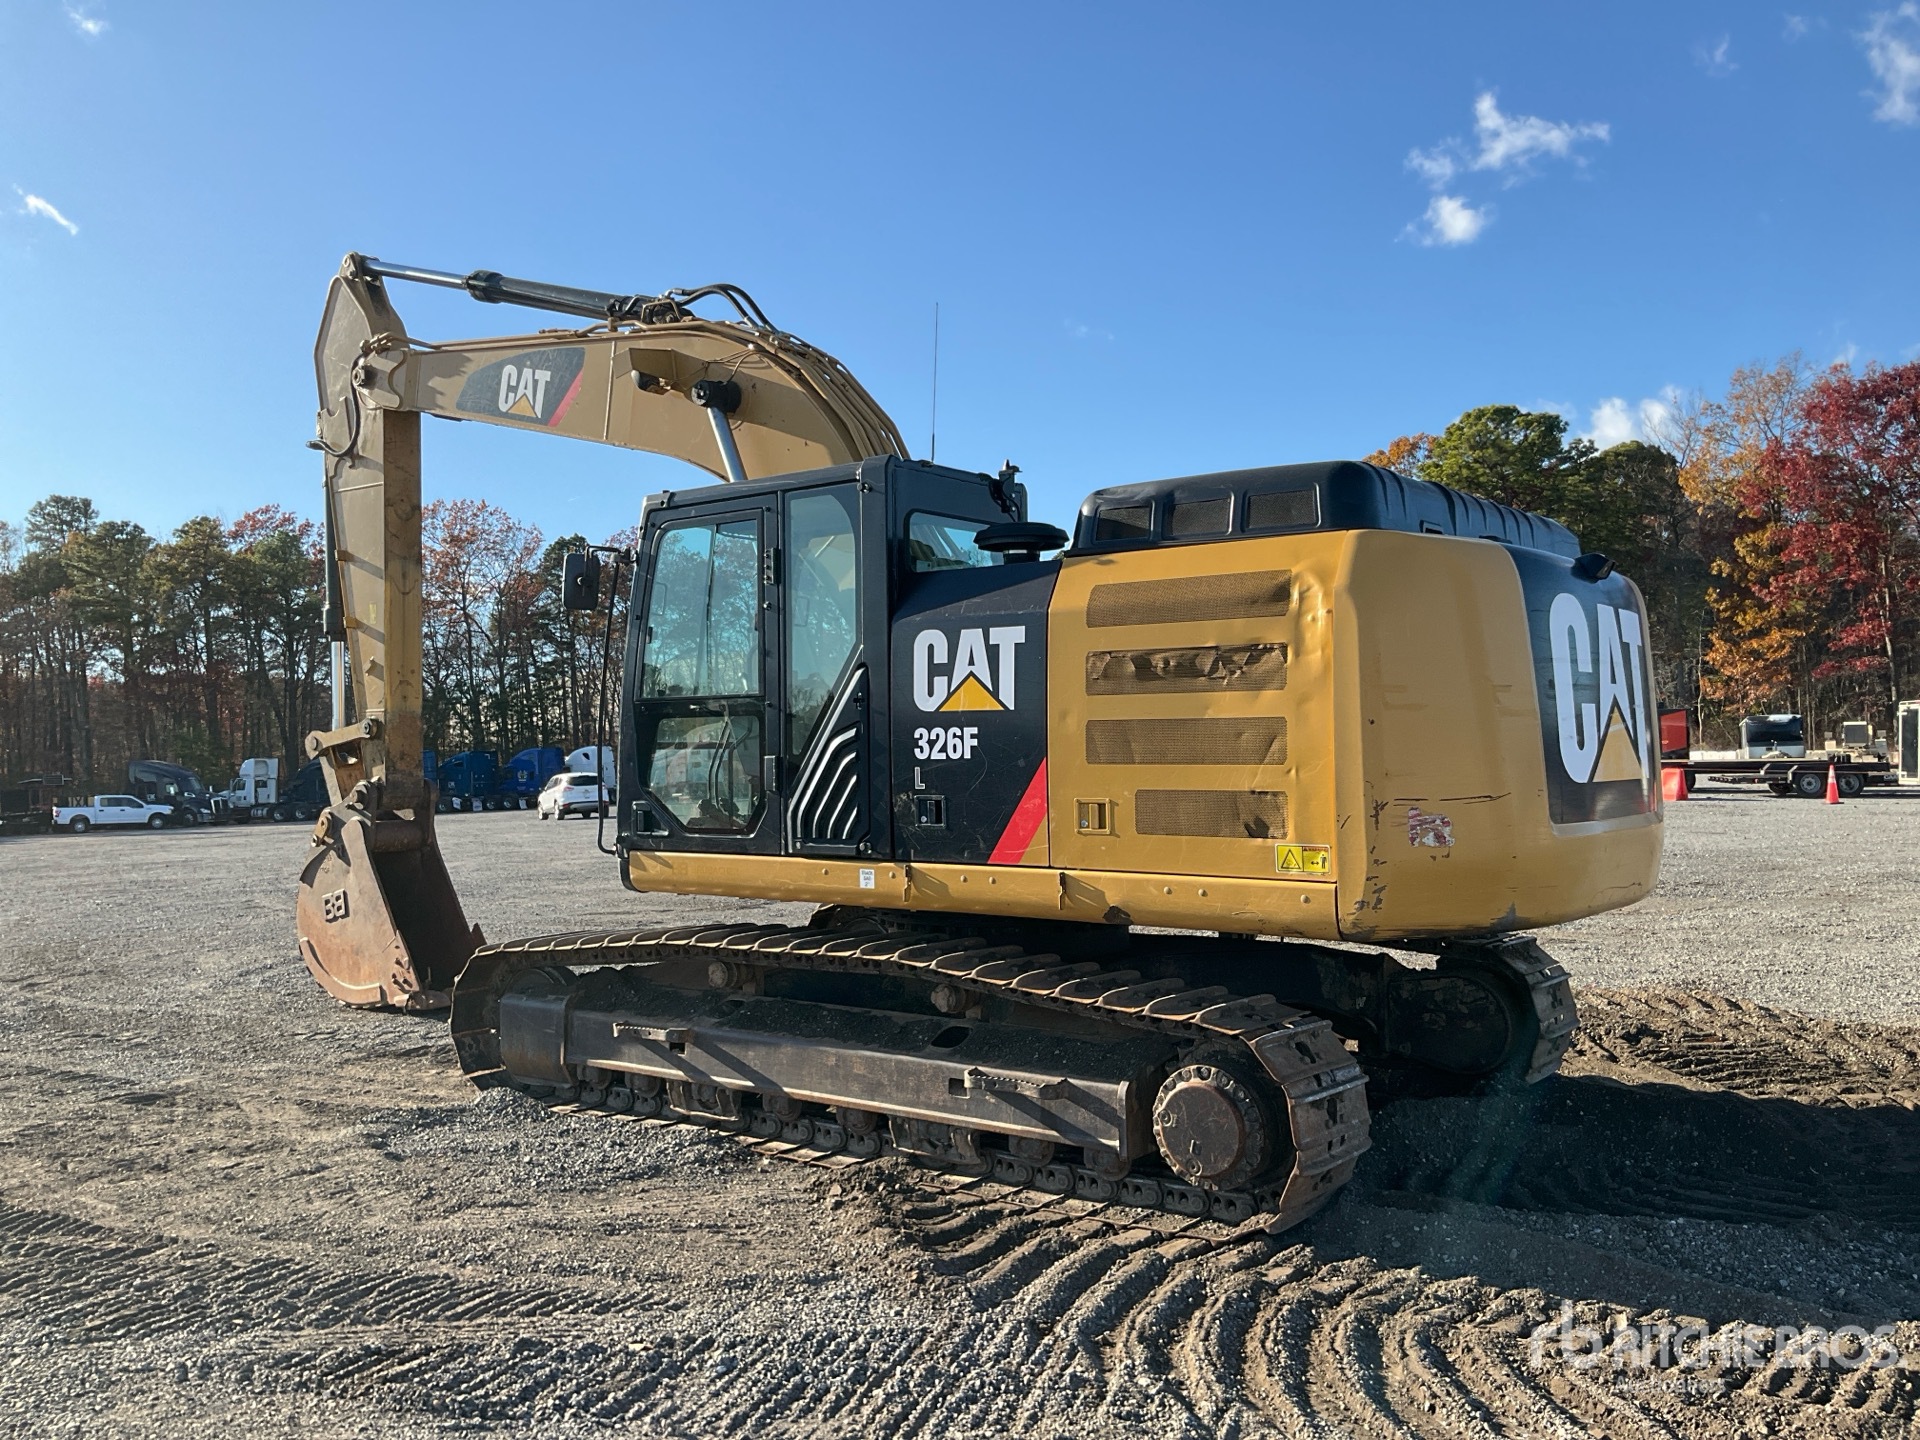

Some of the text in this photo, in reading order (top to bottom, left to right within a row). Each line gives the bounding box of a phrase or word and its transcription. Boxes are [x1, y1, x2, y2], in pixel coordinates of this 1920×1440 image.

[499, 364, 551, 418] CAT
[914, 626, 1025, 712] CAT
[1550, 592, 1649, 783] CAT
[914, 727, 978, 760] 326F
[914, 766, 925, 789] L
